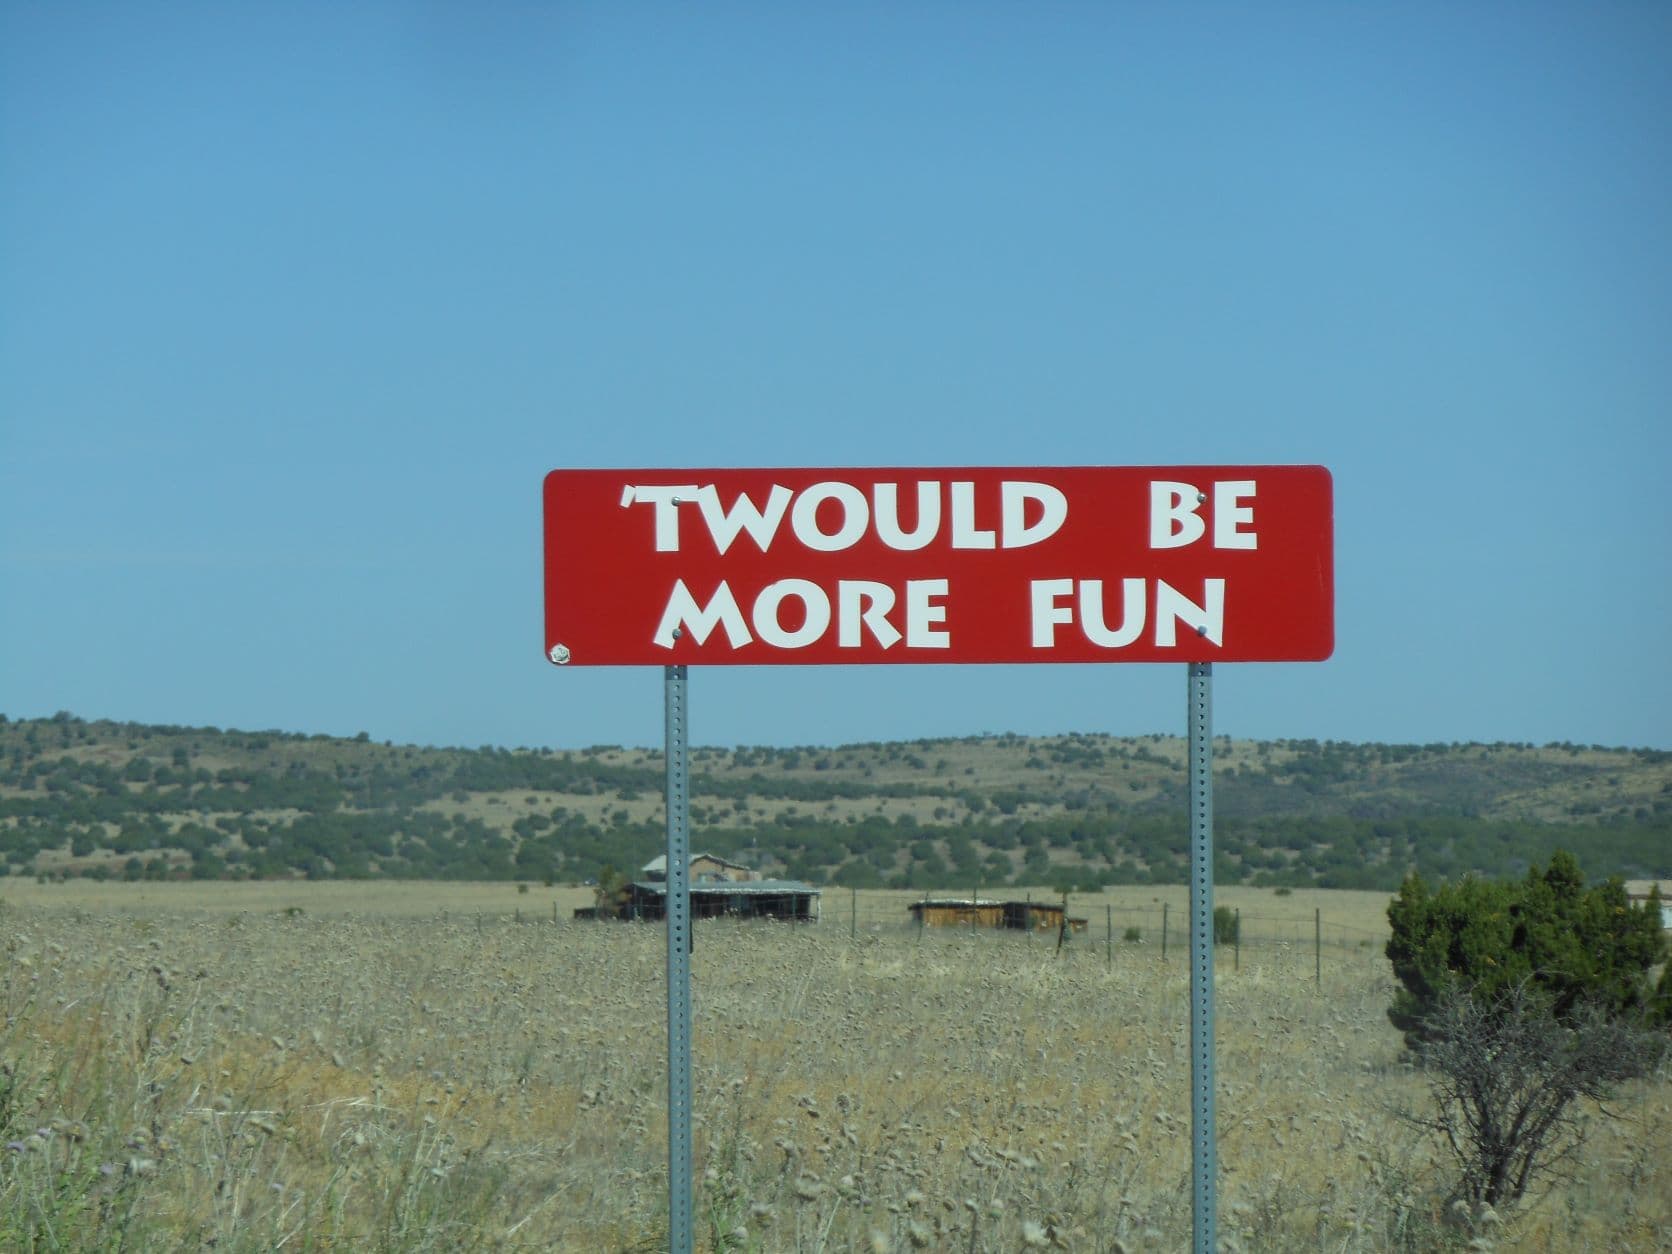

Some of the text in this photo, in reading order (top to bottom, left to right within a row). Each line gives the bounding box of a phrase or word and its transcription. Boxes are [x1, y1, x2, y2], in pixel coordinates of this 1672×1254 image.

[619, 479, 1258, 556] 'TWOULD BE
[652, 577, 1226, 650] MORE FUN
